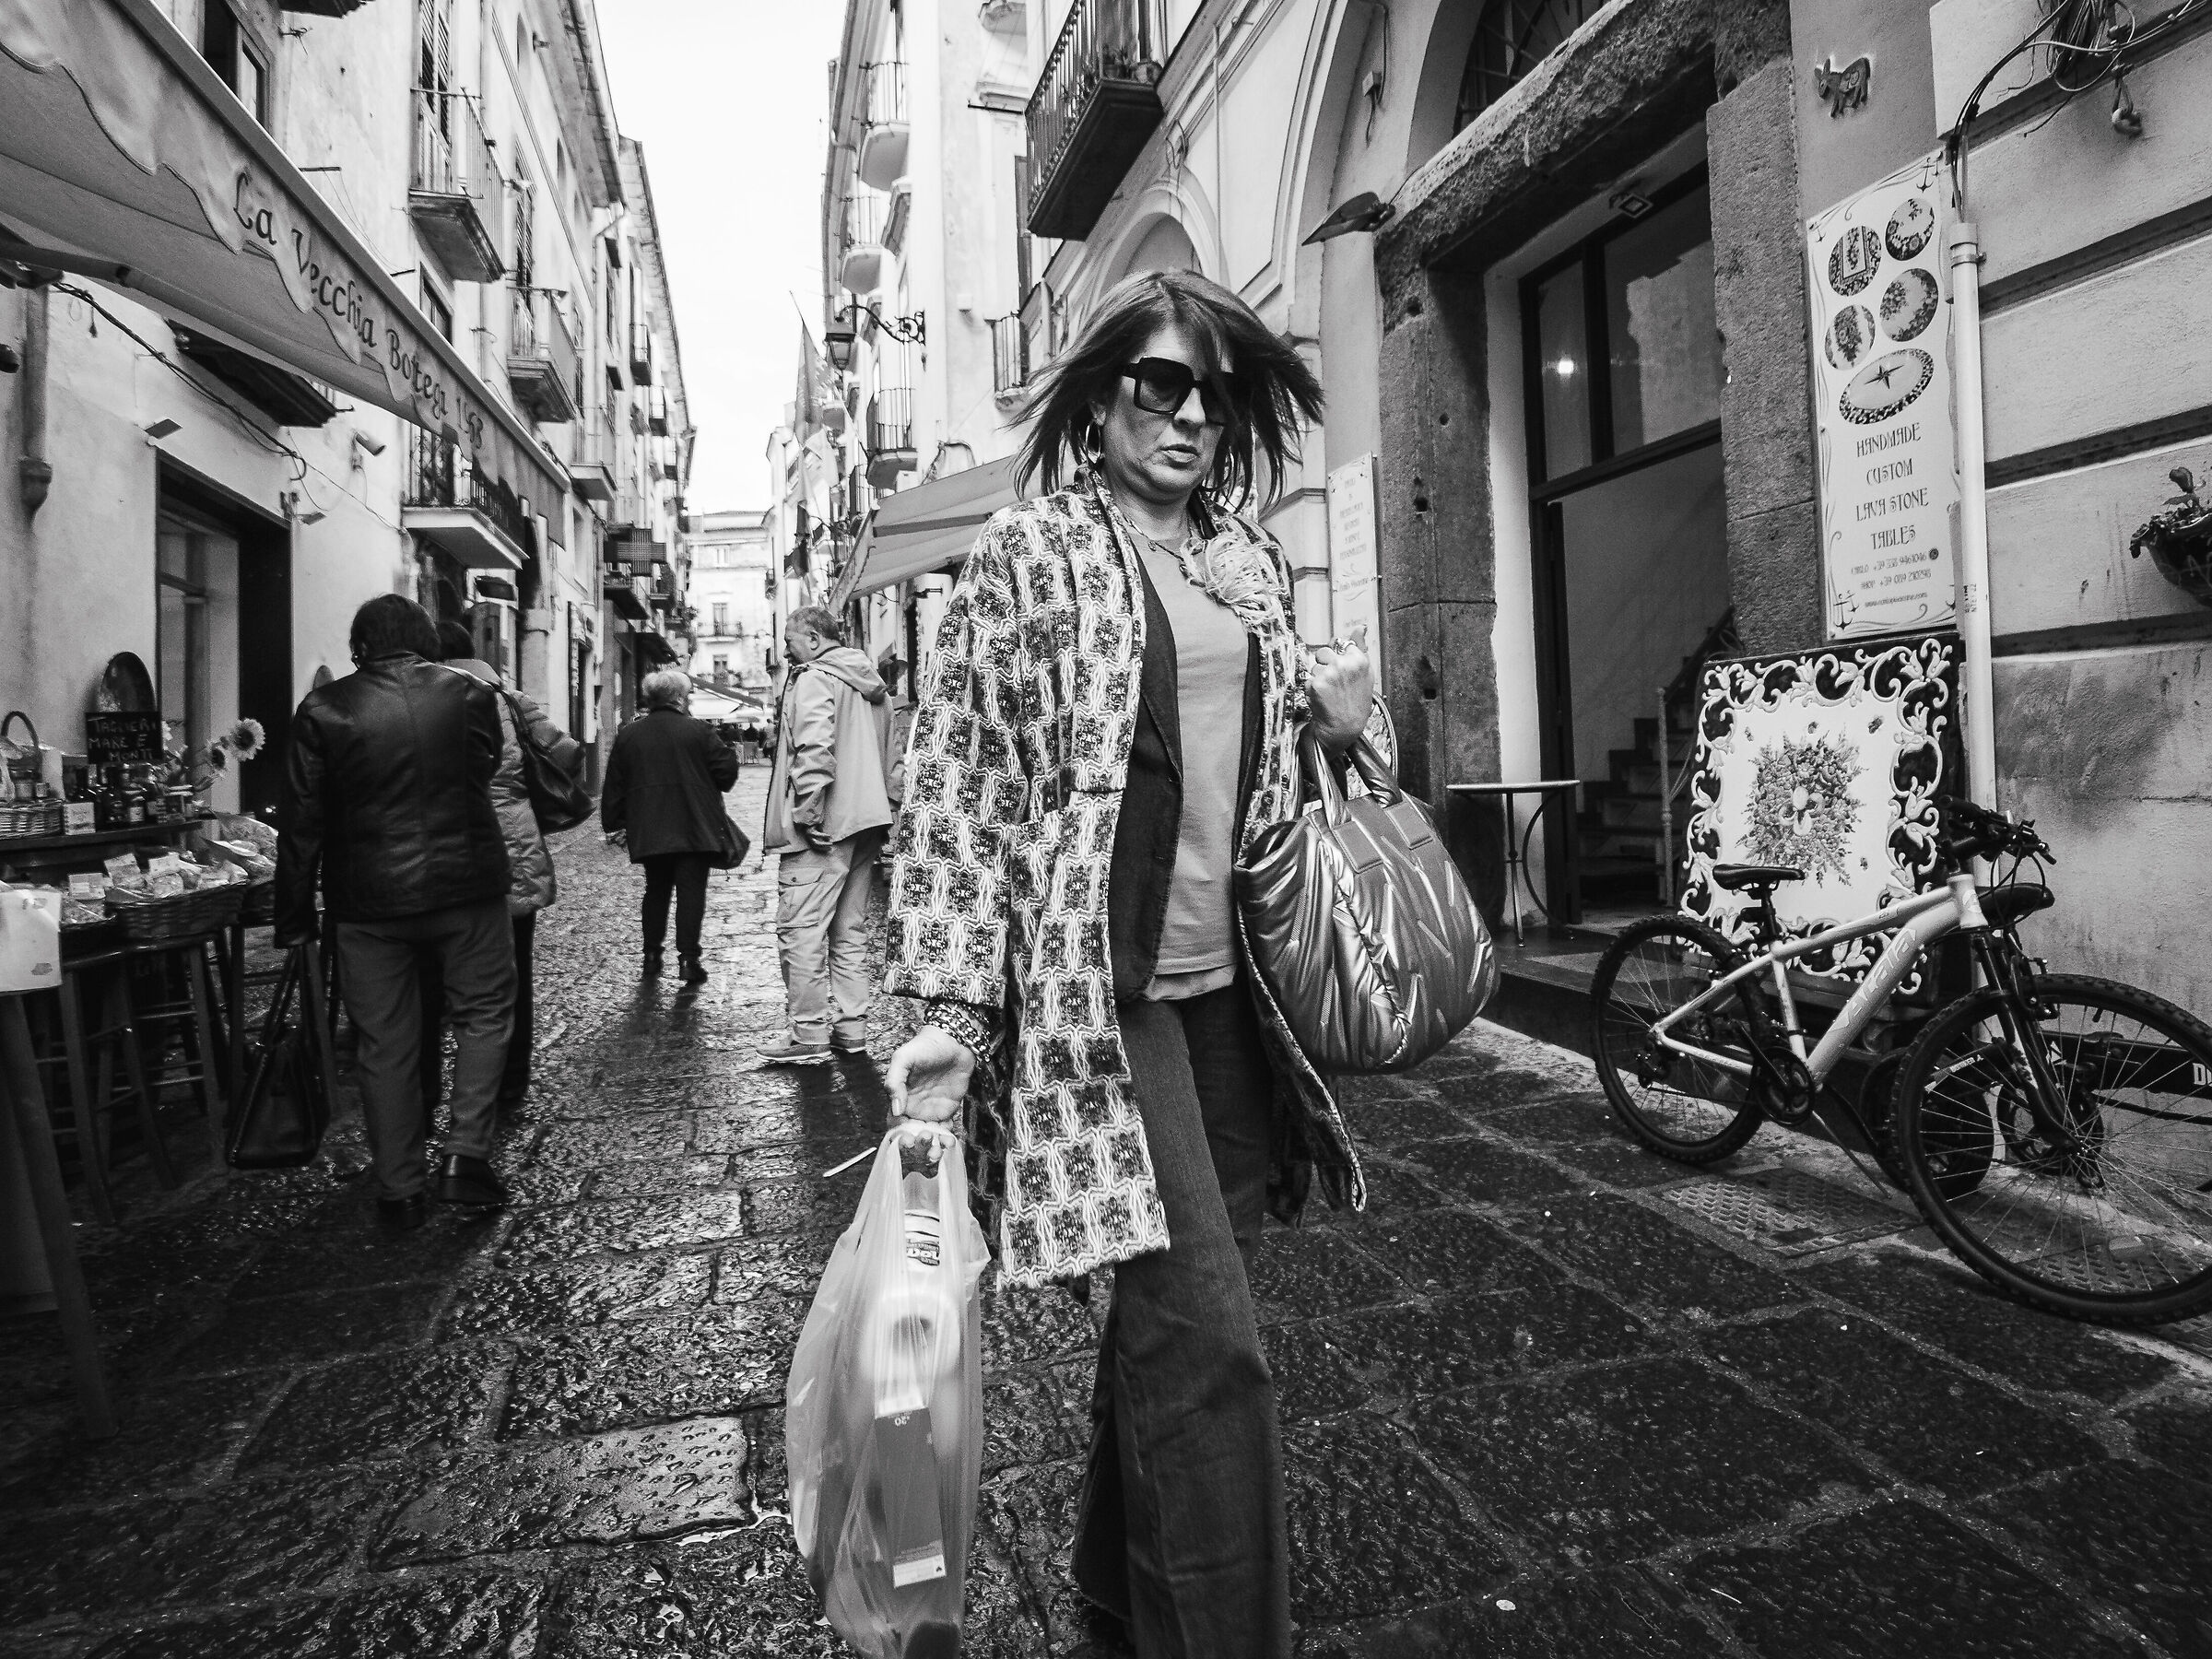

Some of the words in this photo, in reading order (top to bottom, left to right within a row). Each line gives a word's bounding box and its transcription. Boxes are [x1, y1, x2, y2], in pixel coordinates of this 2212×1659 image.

[233, 171, 276, 245] La
[291, 228, 377, 347] Vecchia
[1856, 422, 1922, 457] HANDMADE
[1865, 458, 1913, 486] CUSTOM
[1856, 498, 1887, 522] LAVA
[1889, 487, 1929, 512] STONE
[1870, 524, 1916, 550] TABLES
